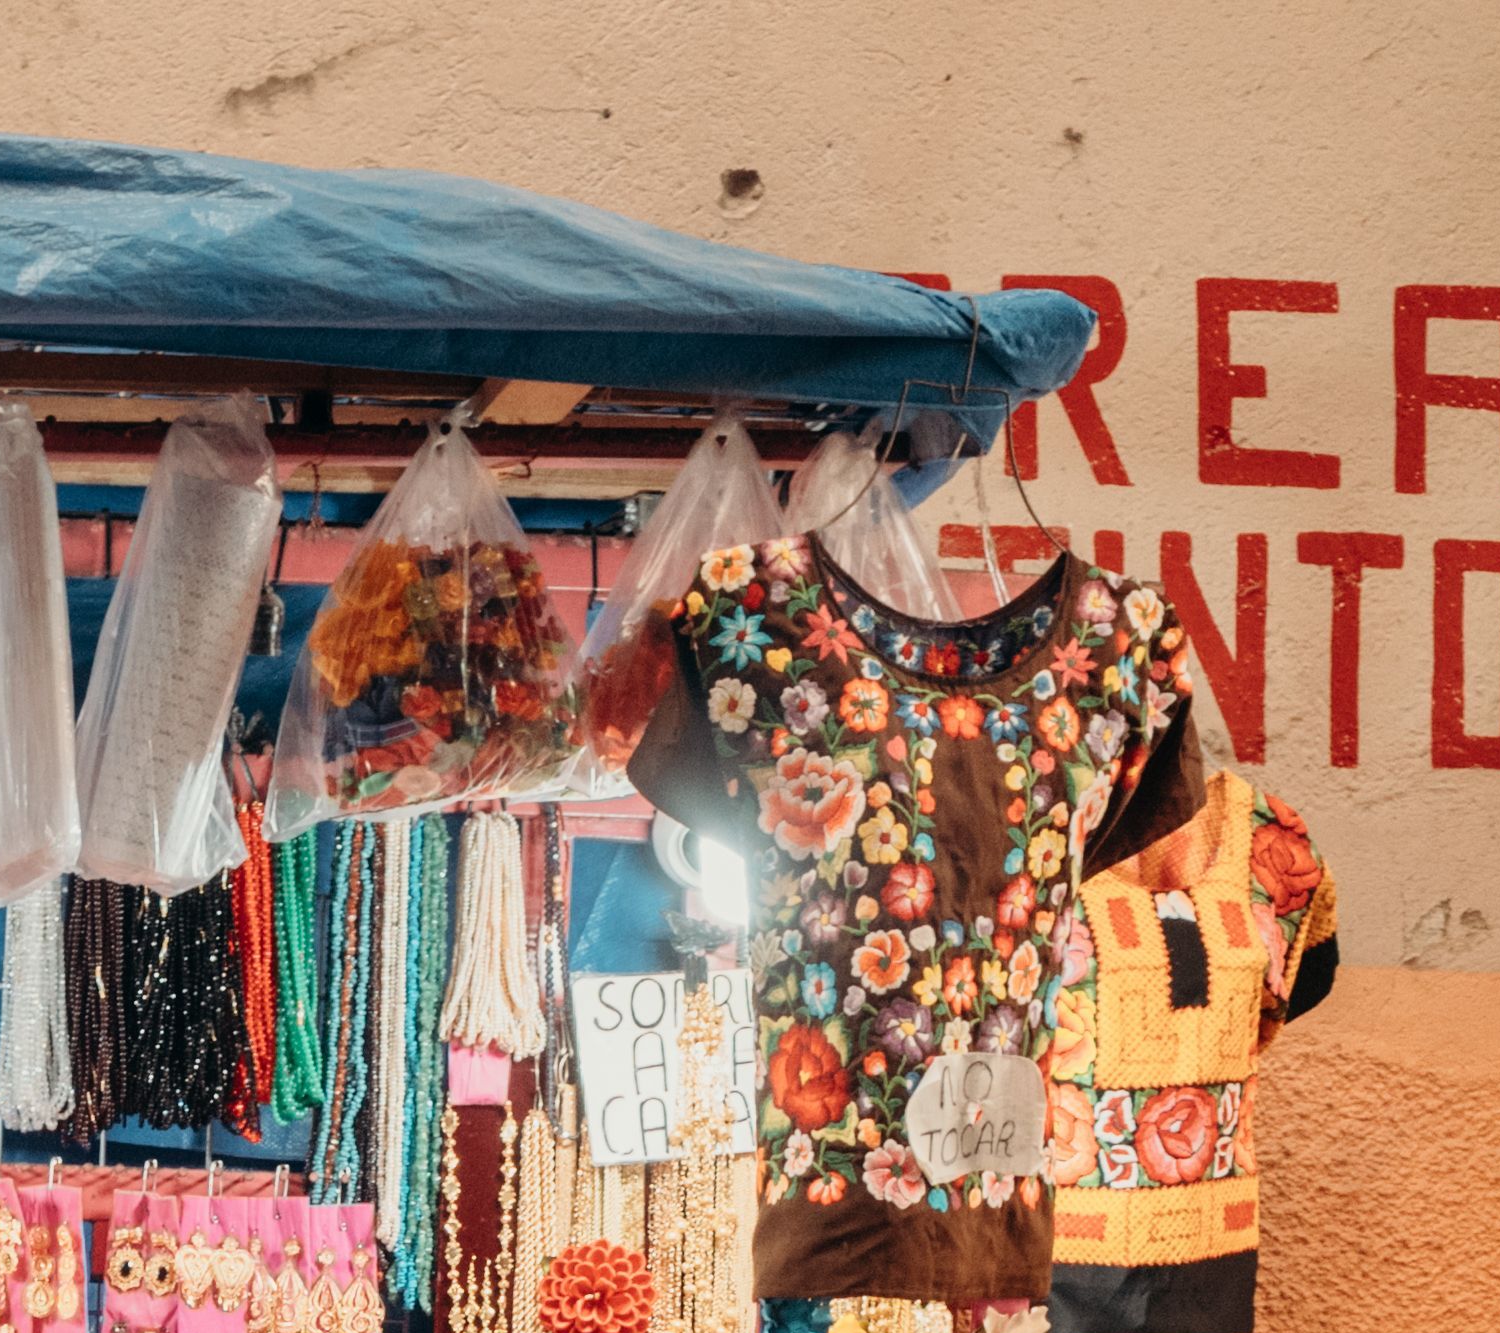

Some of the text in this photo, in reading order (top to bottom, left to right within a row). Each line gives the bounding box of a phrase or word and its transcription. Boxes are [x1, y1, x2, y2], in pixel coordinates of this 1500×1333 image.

[593, 974, 754, 1032] SORI
[632, 1026, 756, 1095] A A
[939, 1060, 994, 1110] NO
[920, 1120, 1016, 1166] TOCAR
